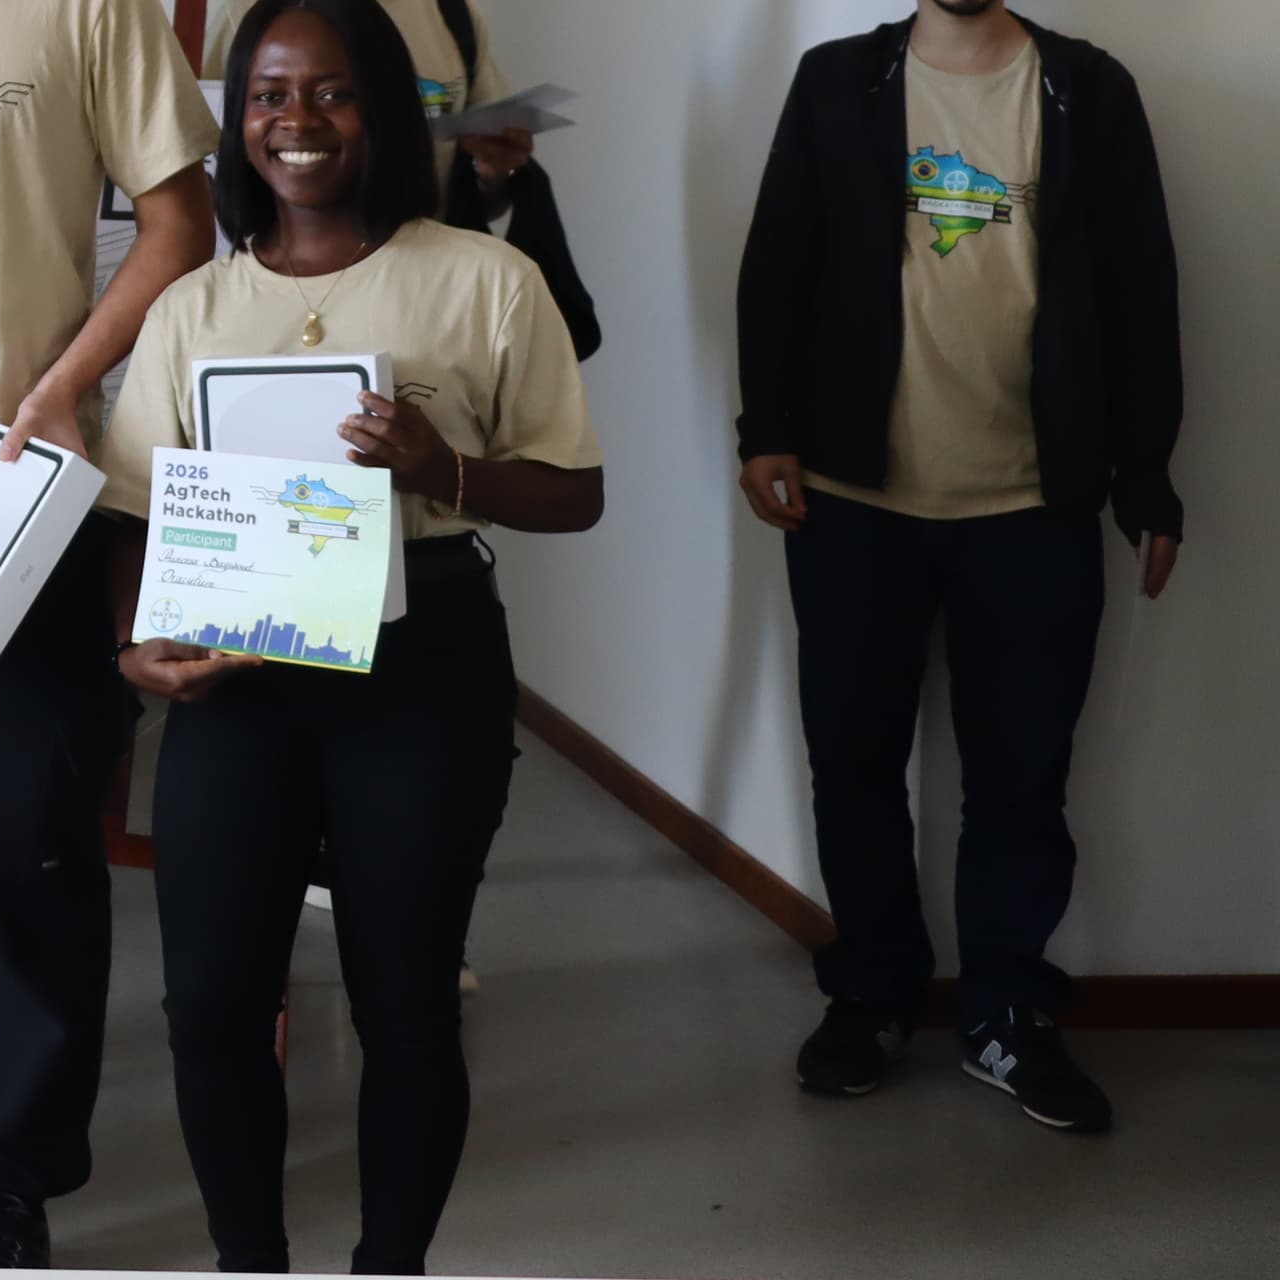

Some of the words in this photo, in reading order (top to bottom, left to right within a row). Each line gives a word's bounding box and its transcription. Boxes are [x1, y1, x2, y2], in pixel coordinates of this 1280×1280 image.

[164, 463, 209, 480] 2026
[163, 483, 231, 503] AgTech
[163, 502, 257, 525] Hackathon
[165, 530, 233, 549] Participant
